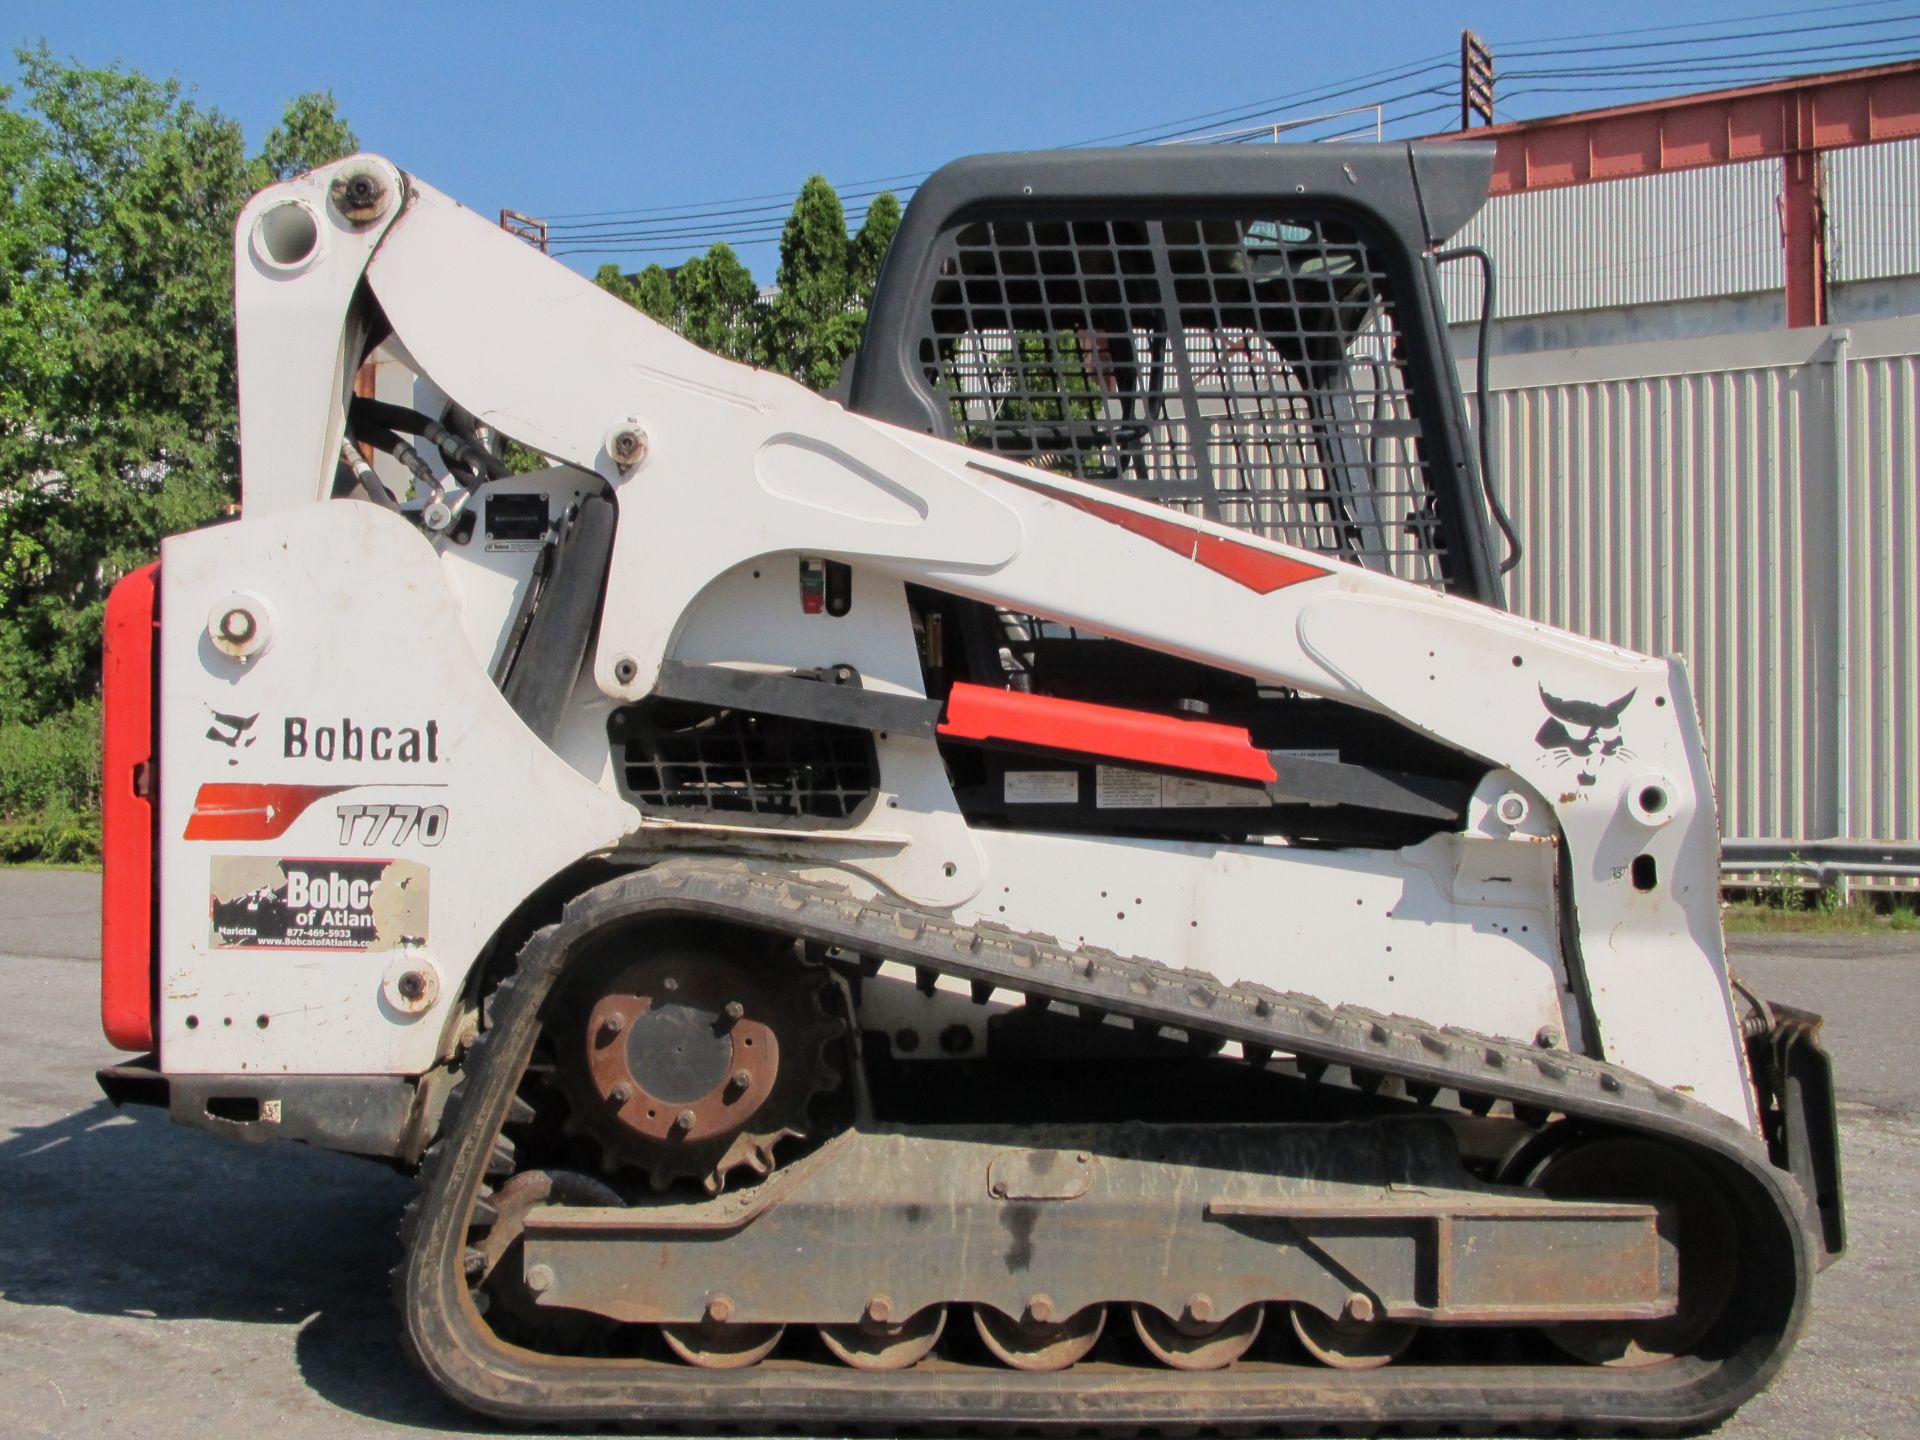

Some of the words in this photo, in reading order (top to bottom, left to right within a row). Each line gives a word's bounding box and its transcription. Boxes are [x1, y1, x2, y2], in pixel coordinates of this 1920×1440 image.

[284, 717, 439, 763] Bobcat
[336, 804, 449, 847] T770
[295, 909, 317, 926] of
[321, 910, 376, 927] Atlan
[218, 926, 257, 936] Marietta
[286, 928, 351, 938] 877-469-5933
